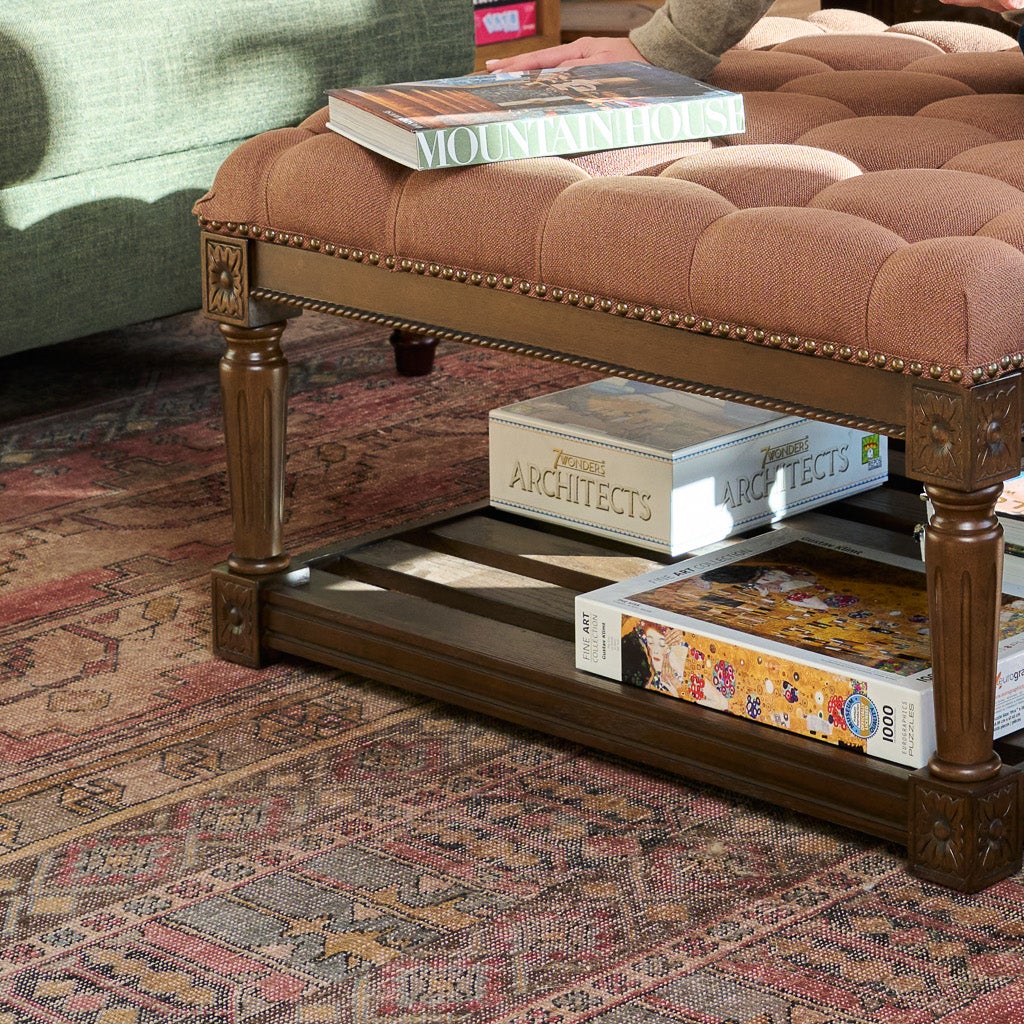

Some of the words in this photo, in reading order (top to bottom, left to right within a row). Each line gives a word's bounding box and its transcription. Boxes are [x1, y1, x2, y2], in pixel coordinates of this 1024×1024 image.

[416, 105, 614, 172] MOUNTAIN
[621, 93, 746, 144] HOUSE
[553, 448, 563, 470] 7
[560, 455, 606, 475] WONDERS
[761, 445, 771, 468] 7
[768, 438, 809, 461] WONDERS
[508, 460, 652, 522] ARCHITECTS
[722, 445, 850, 508] ARCHITECTS
[673, 567, 695, 577] ART
[693, 549, 753, 571] COLLECTION
[582, 611, 590, 634] ART
[582, 636, 590, 661] FINE
[844, 698, 855, 729] MUSEUM
[882, 704, 894, 743] 1000
